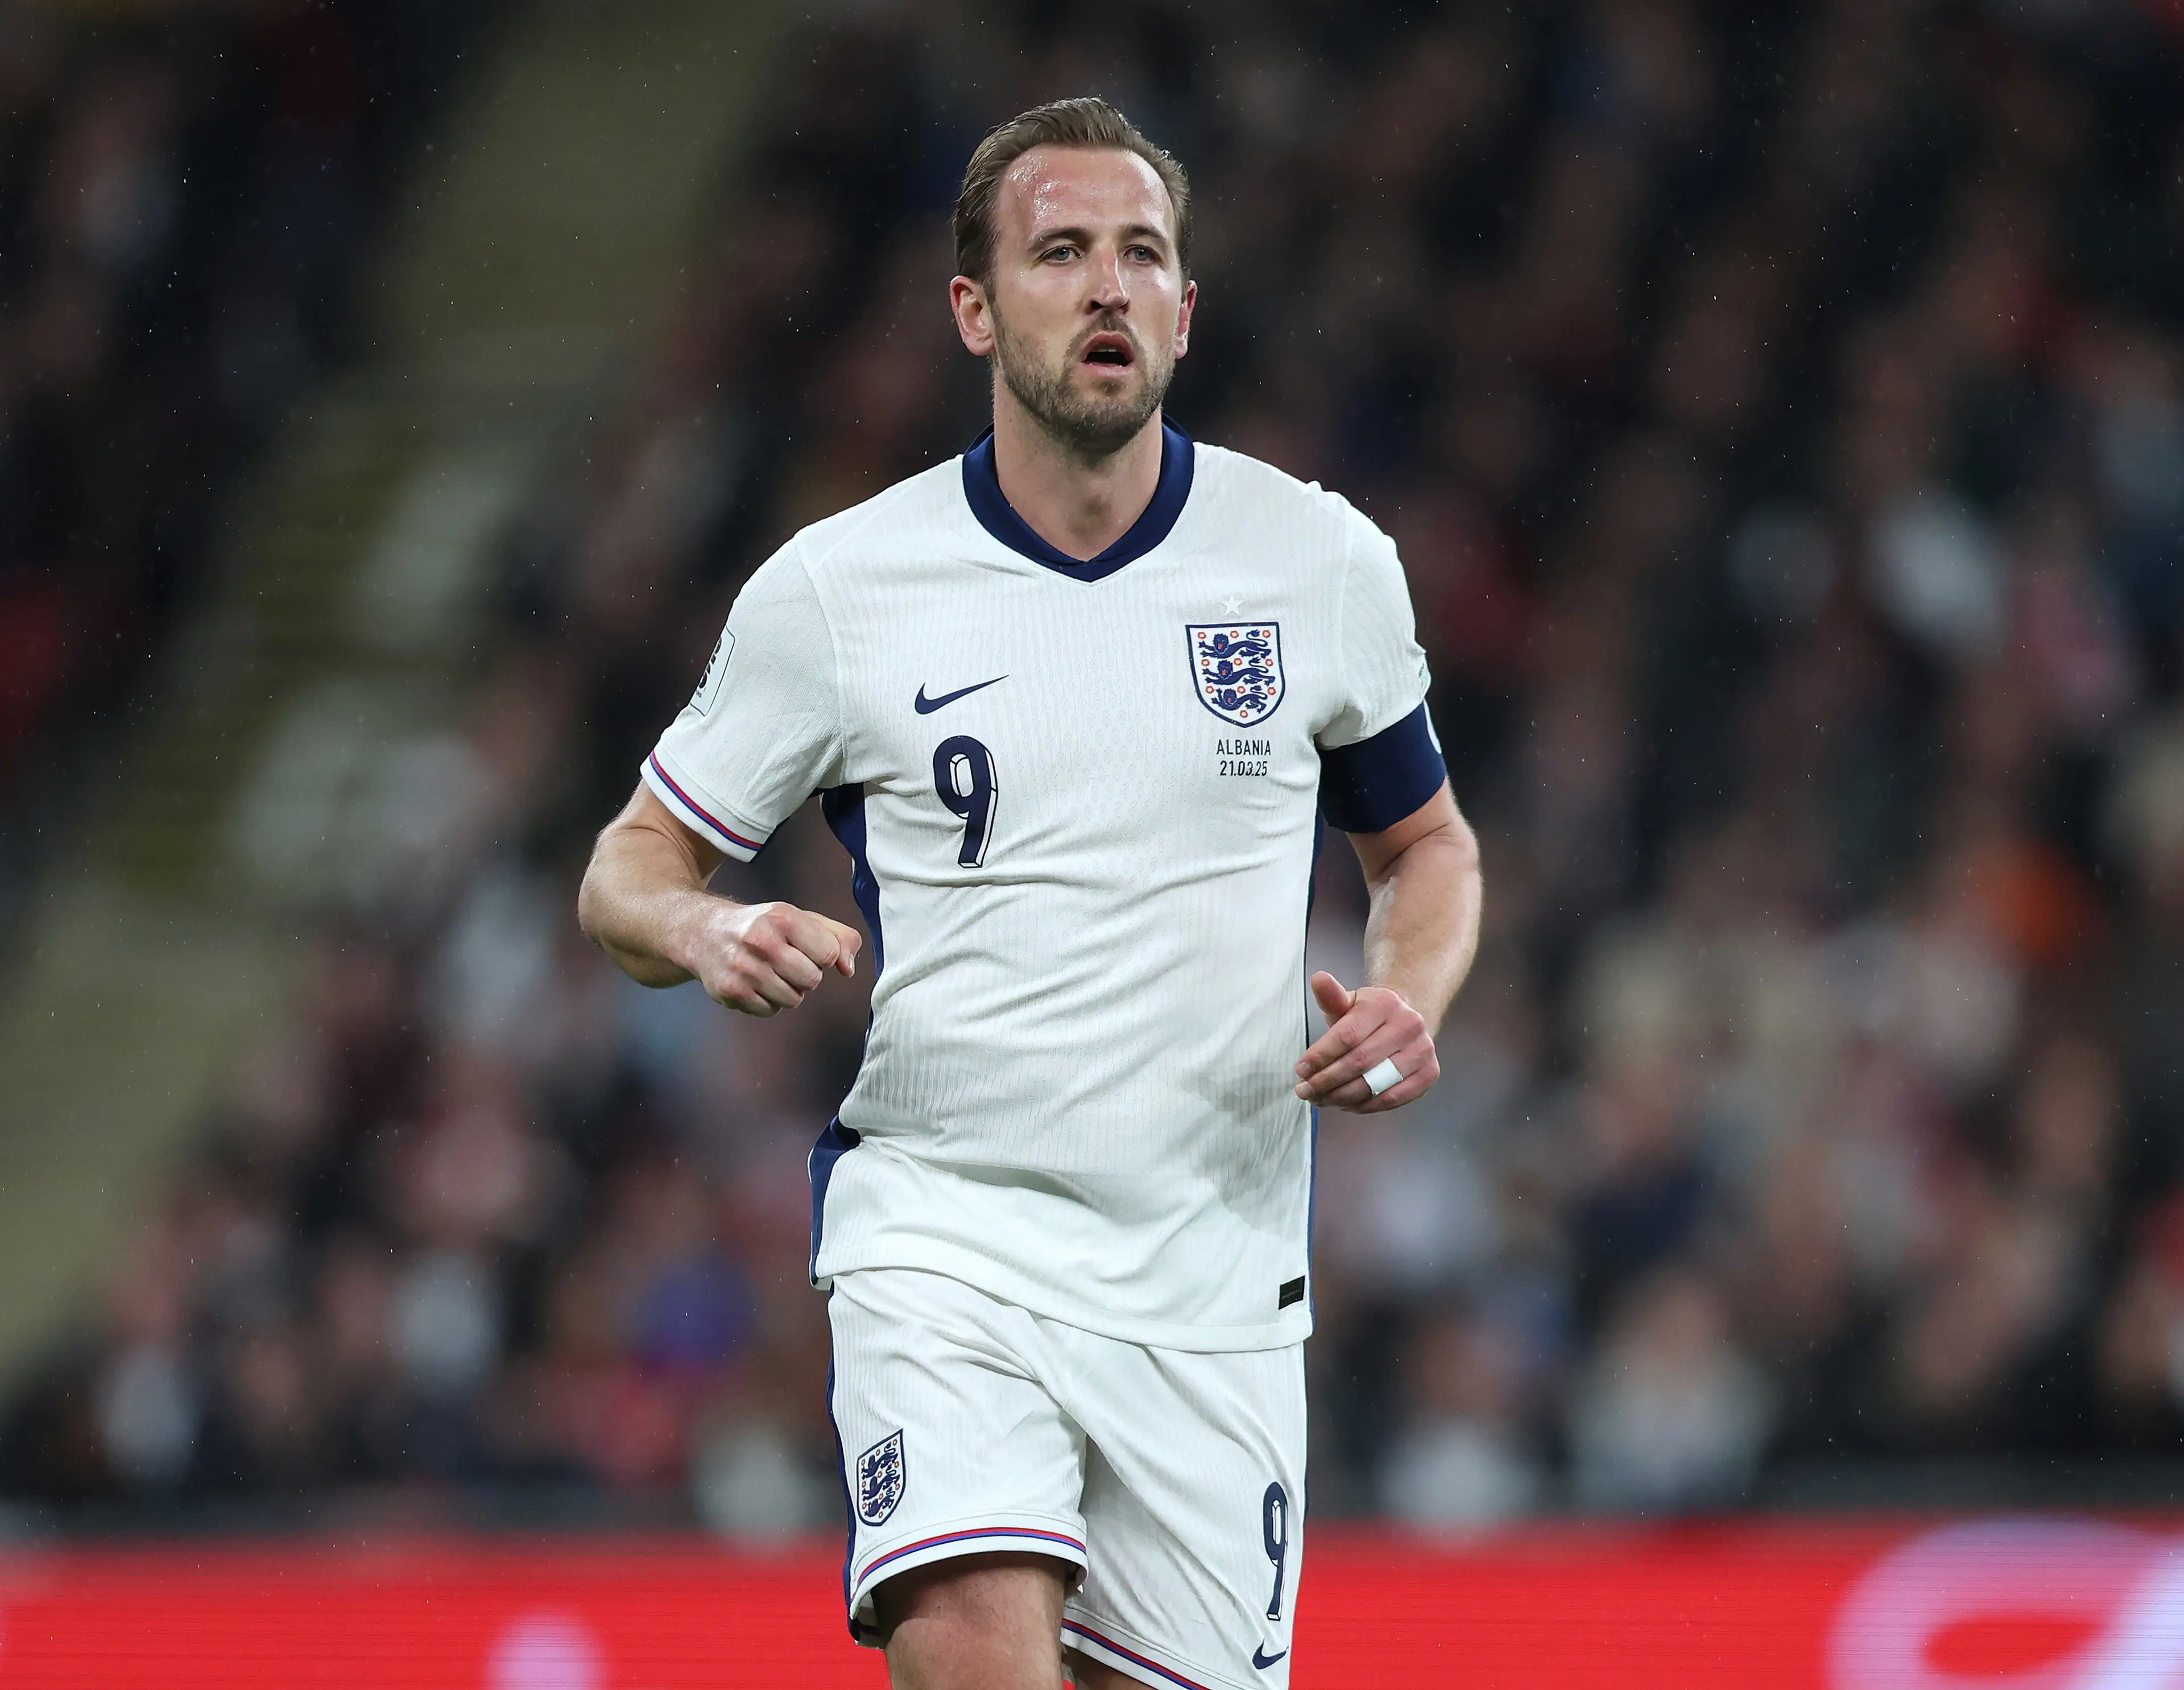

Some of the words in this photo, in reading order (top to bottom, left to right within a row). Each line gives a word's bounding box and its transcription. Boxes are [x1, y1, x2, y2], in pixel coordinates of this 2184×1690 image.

[1217, 739, 1271, 755] ALBANIA
[1220, 760, 1267, 776] 21.03.25
[933, 735, 998, 868] 9
[1263, 1481, 1288, 1621] 9
